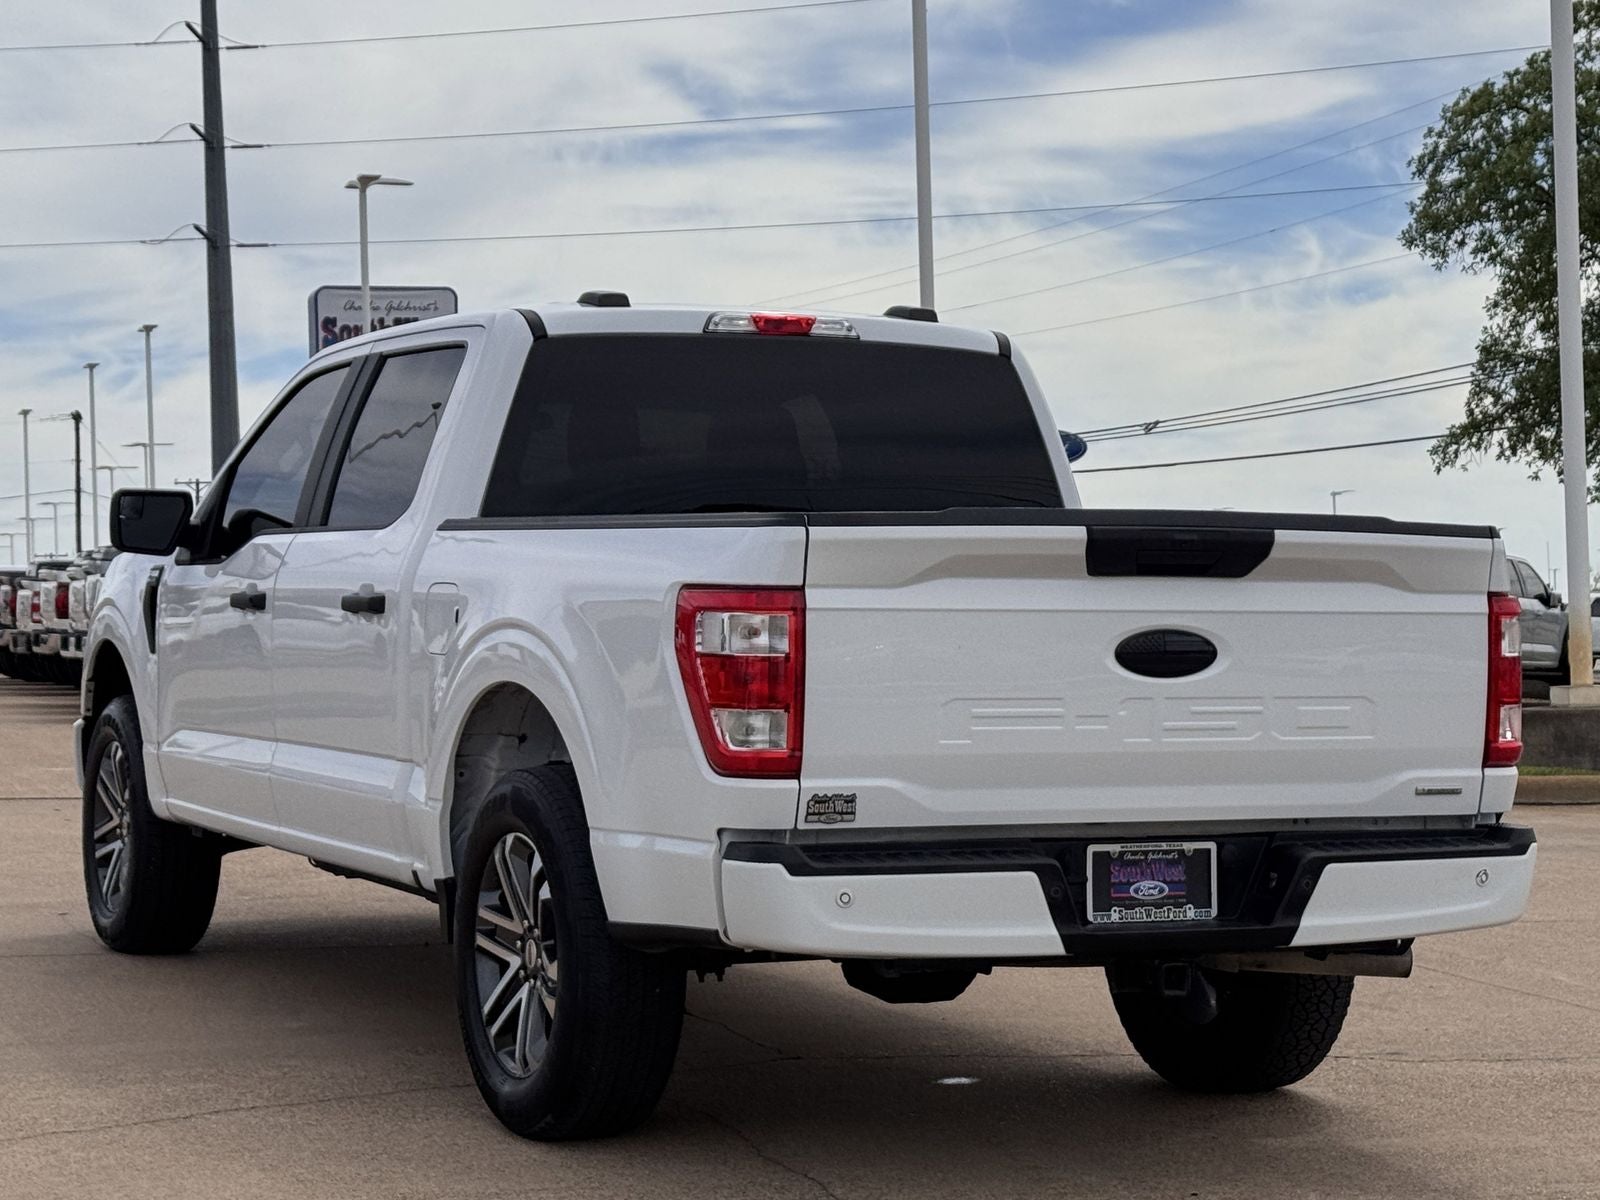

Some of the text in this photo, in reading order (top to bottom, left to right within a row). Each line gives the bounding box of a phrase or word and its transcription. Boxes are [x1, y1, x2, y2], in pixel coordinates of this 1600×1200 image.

[343, 299, 381, 312] Chalie
[938, 696, 1375, 744] F-150
[1110, 862, 1186, 882] SouthWest
[1138, 883, 1161, 896] Ford
[1093, 906, 1212, 921] www.SouthWestFord.com
